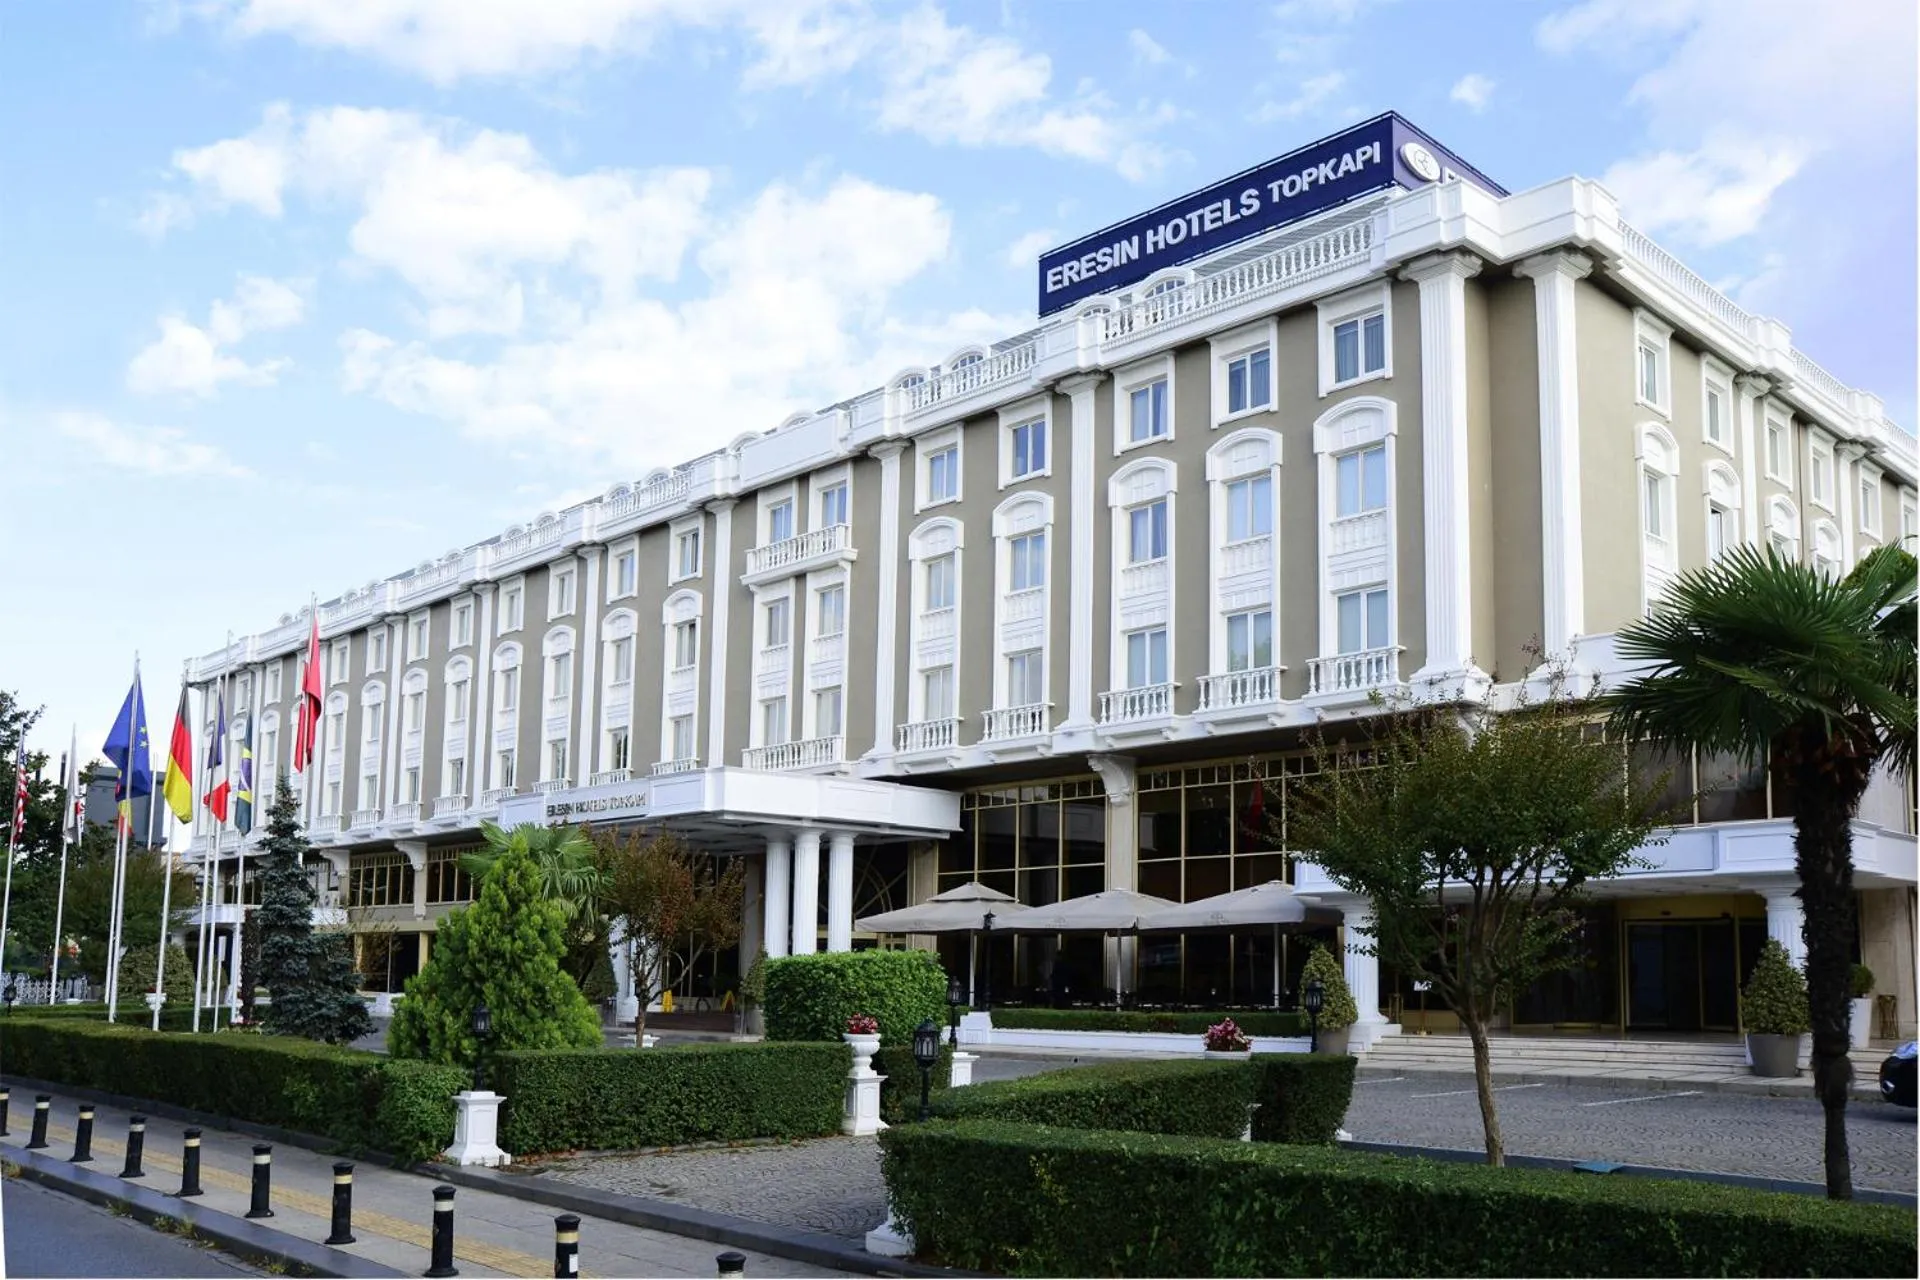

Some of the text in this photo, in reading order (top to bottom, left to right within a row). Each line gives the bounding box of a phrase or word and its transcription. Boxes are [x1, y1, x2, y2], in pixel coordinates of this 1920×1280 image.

[1046, 235, 1139, 293] ERESIN
[1146, 188, 1260, 253] HOTELS
[1267, 141, 1381, 203] TOPKAPI
